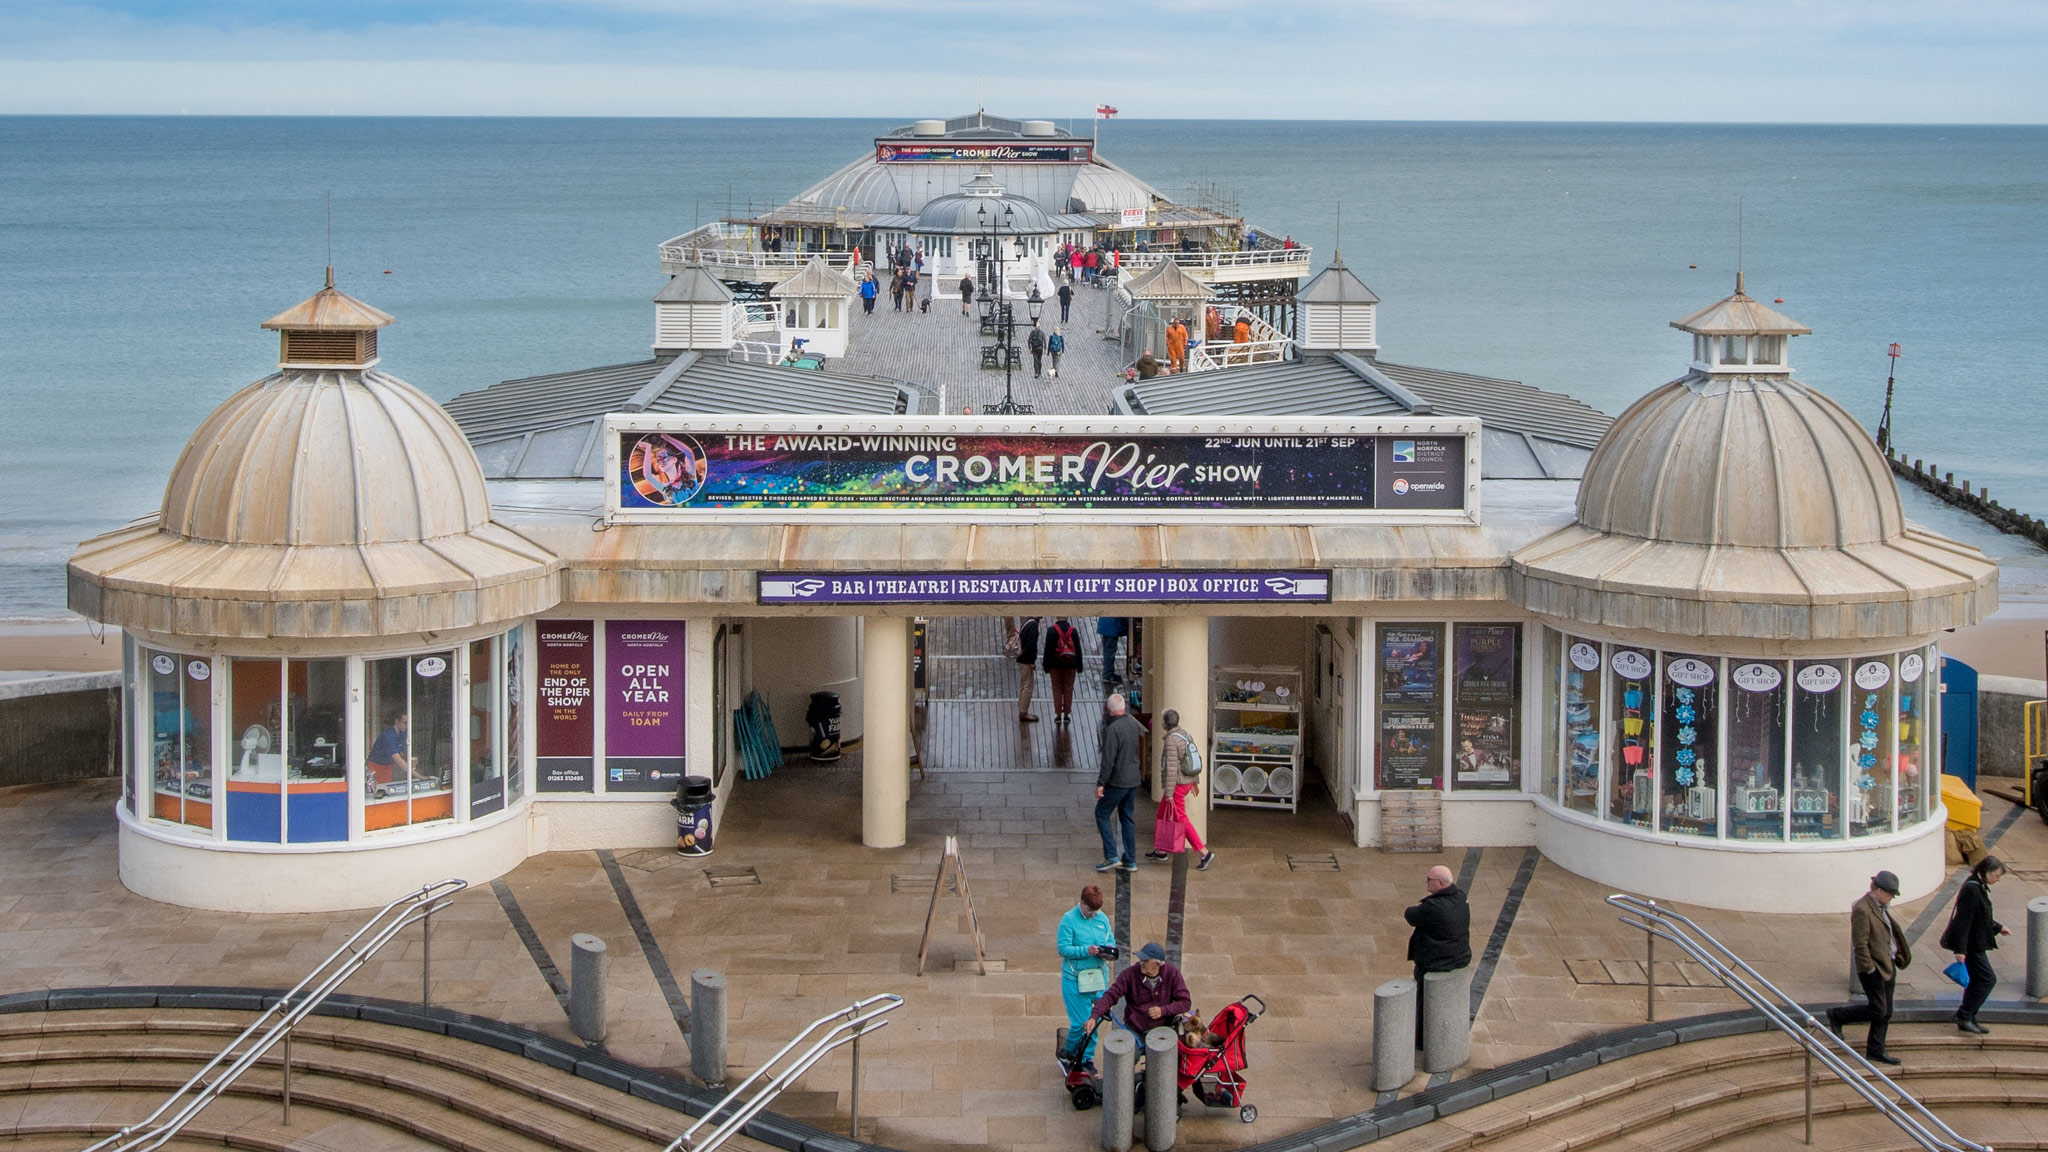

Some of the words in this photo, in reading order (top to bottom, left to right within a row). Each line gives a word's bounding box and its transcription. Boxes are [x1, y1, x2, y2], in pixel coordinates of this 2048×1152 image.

[996, 146, 1021, 158] Pier
[725, 435, 766, 450] THE
[774, 436, 957, 451] AWARD-WINNING
[1205, 437, 1231, 448] 22ND
[1234, 438, 1260, 448] JUN
[1264, 438, 1302, 448] UNTIL
[1305, 437, 1328, 448] 21ST
[1331, 438, 1355, 448] SEP
[905, 455, 1085, 483] CROMER
[1081, 441, 1189, 490] Pier
[1195, 465, 1262, 482] SHOW
[1410, 482, 1445, 491] openwide
[832, 581, 865, 594] BAR
[876, 580, 948, 594] THEATRE
[958, 579, 1063, 593] RESTAURANT
[1074, 579, 1111, 592] GIFT
[1115, 579, 1157, 592] SHOP
[1167, 579, 1199, 592] BOX
[1203, 579, 1259, 592] OFFICE
[570, 631, 589, 640] Pier
[650, 631, 669, 640] Pier
[622, 664, 669, 676] OPEN
[544, 678, 568, 686] END
[570, 678, 587, 686] OF
[629, 678, 662, 689] ALL
[540, 688, 562, 696] THE
[565, 688, 590, 696] PIER
[622, 690, 669, 702] YEAR
[548, 697, 583, 706] SHOW
